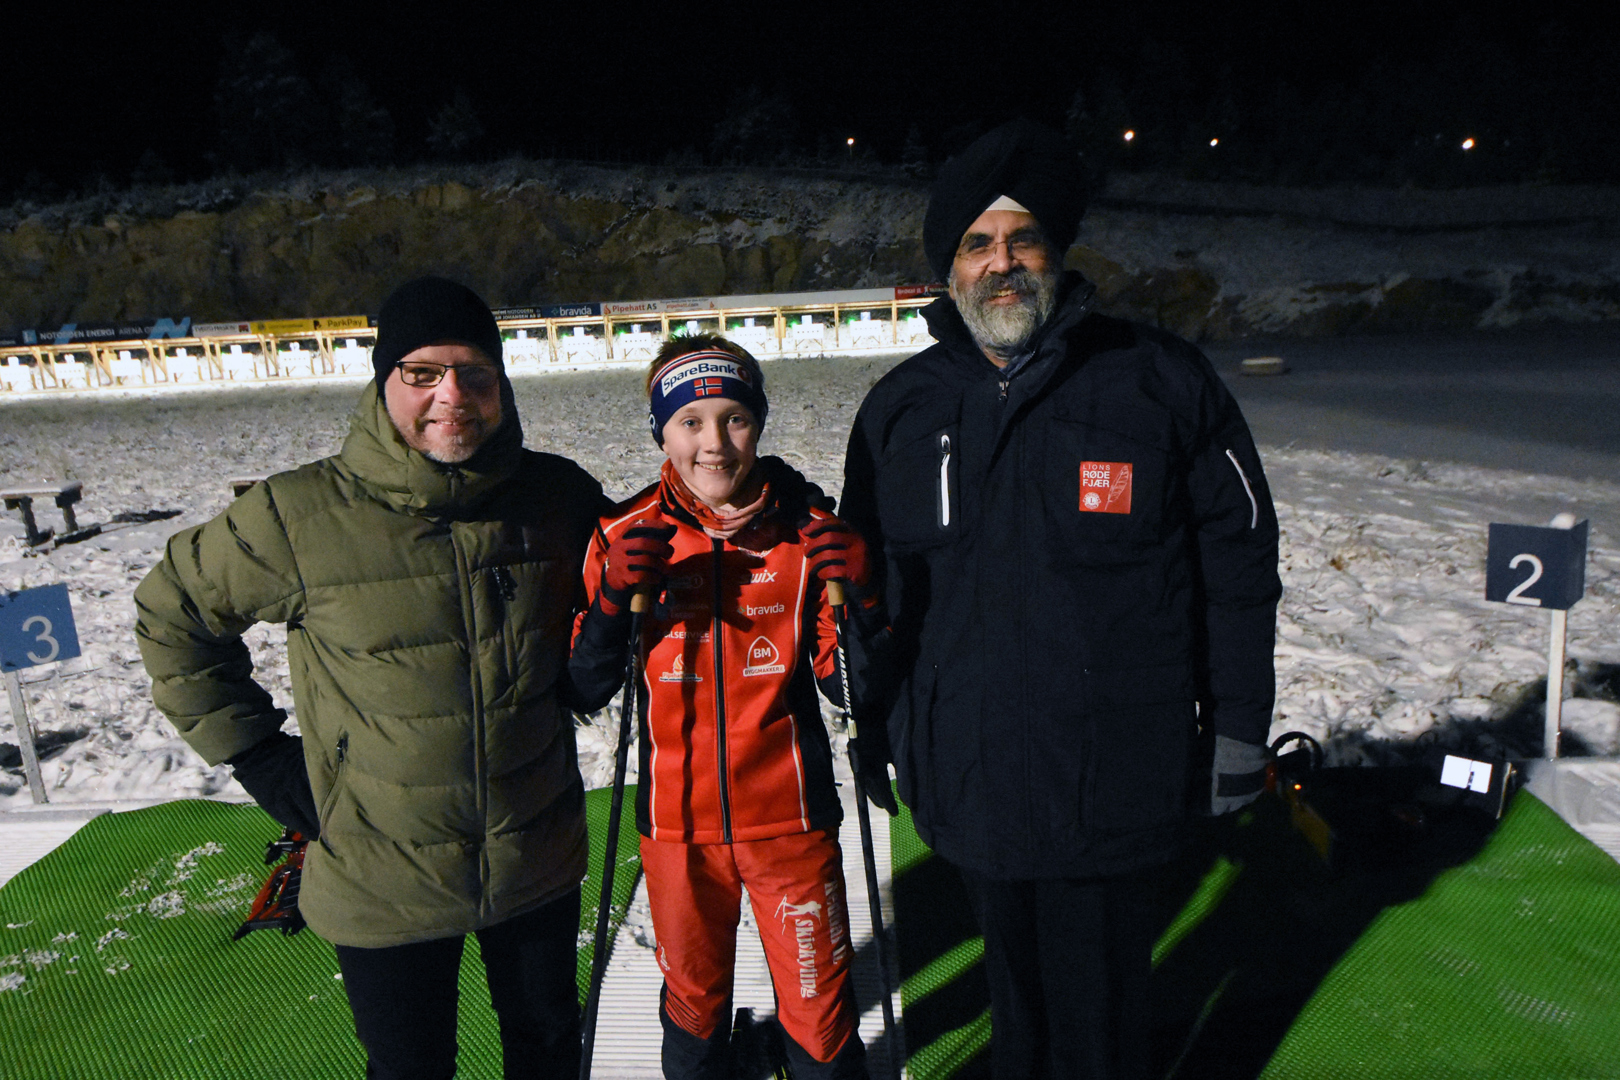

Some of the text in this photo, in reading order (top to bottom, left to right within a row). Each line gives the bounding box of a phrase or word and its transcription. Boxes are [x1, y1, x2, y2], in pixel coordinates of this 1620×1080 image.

[559, 306, 592, 316] bravida
[612, 304, 645, 313] Pipehatt
[646, 303, 657, 311] AS
[327, 318, 363, 328] ParkPay
[86, 328, 115, 338] ENERGI
[663, 362, 737, 391] SpareBank
[1083, 470, 1110, 479] RØDE
[1082, 479, 1110, 488] FJÆR
[751, 569, 778, 583] wix
[1506, 553, 1543, 607] 2
[746, 602, 785, 616] bravida
[22, 615, 60, 664] 3
[753, 647, 771, 659] BM
[837, 646, 852, 716] MADSHUS
[795, 918, 820, 999] Skiskyting
